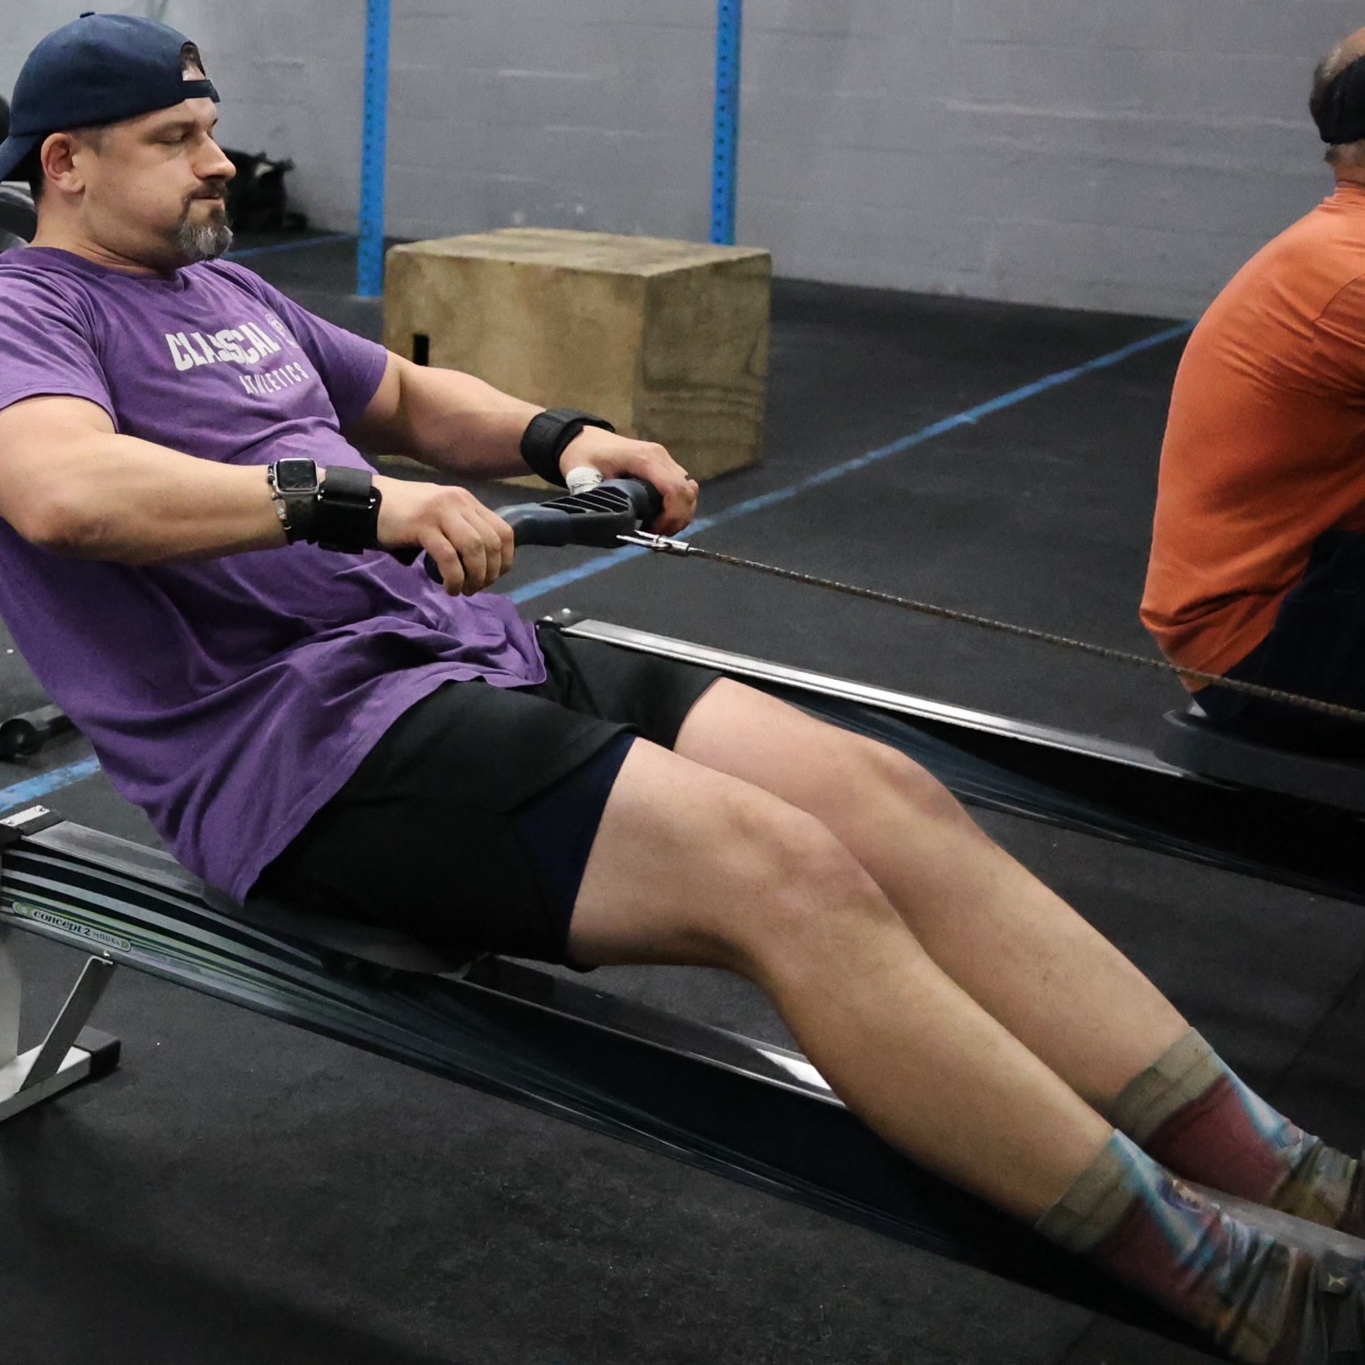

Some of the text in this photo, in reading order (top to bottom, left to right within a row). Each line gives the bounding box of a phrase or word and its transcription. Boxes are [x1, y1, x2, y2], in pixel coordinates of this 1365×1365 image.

[239, 361, 310, 394] ATHLETICS
[33, 910, 83, 934] concept
[83, 927, 91, 936] 2
[92, 931, 121, 946] MODEL
